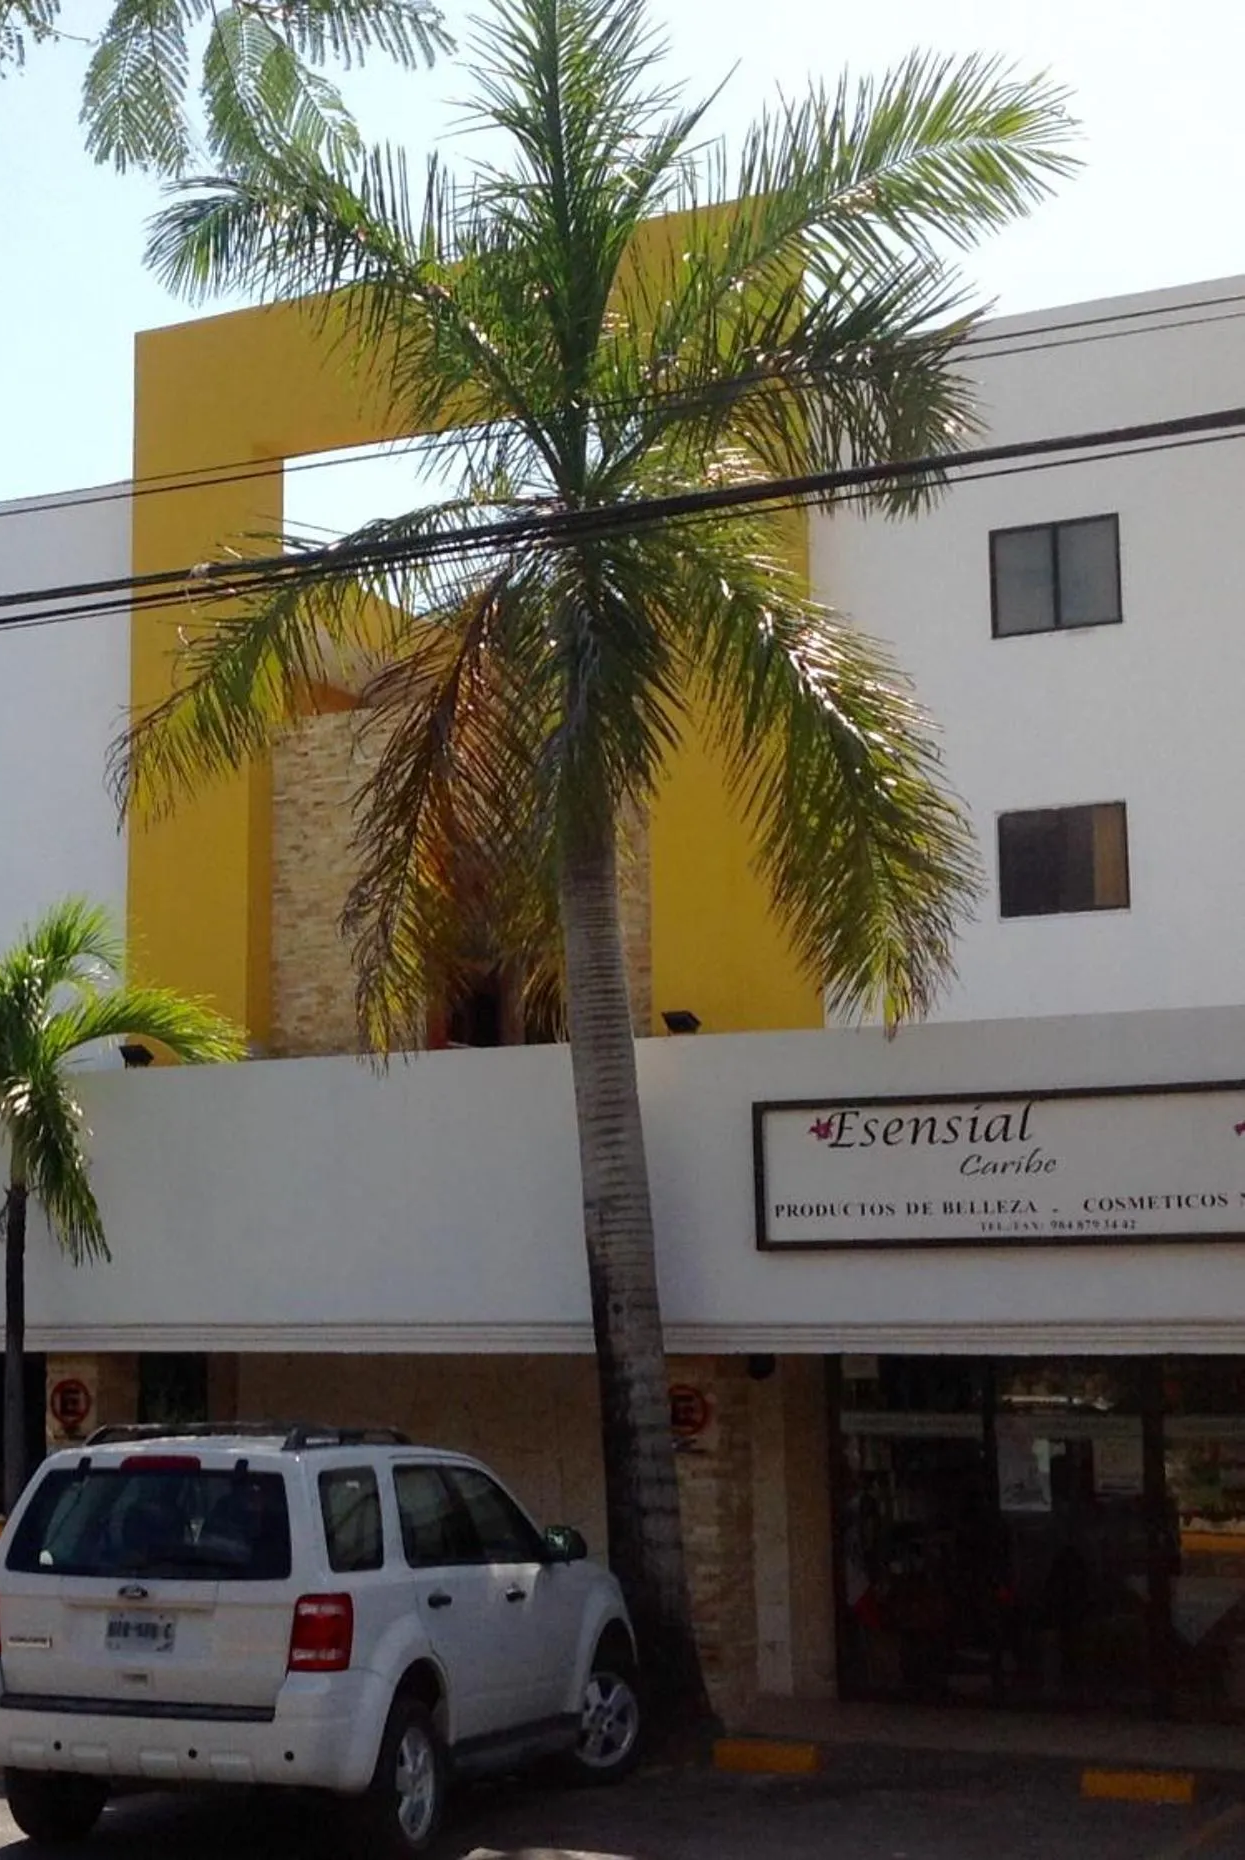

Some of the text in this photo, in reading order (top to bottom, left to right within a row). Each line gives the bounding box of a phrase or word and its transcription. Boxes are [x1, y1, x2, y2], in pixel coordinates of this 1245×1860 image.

[827, 1100, 1035, 1149] Esensial
[960, 1147, 1058, 1177] Caribe
[774, 1201, 897, 1219] PRODUCTOS
[905, 1201, 935, 1217] DE
[942, 1199, 1039, 1215] BELLEZA
[1082, 1193, 1230, 1214] COSMETICOS
